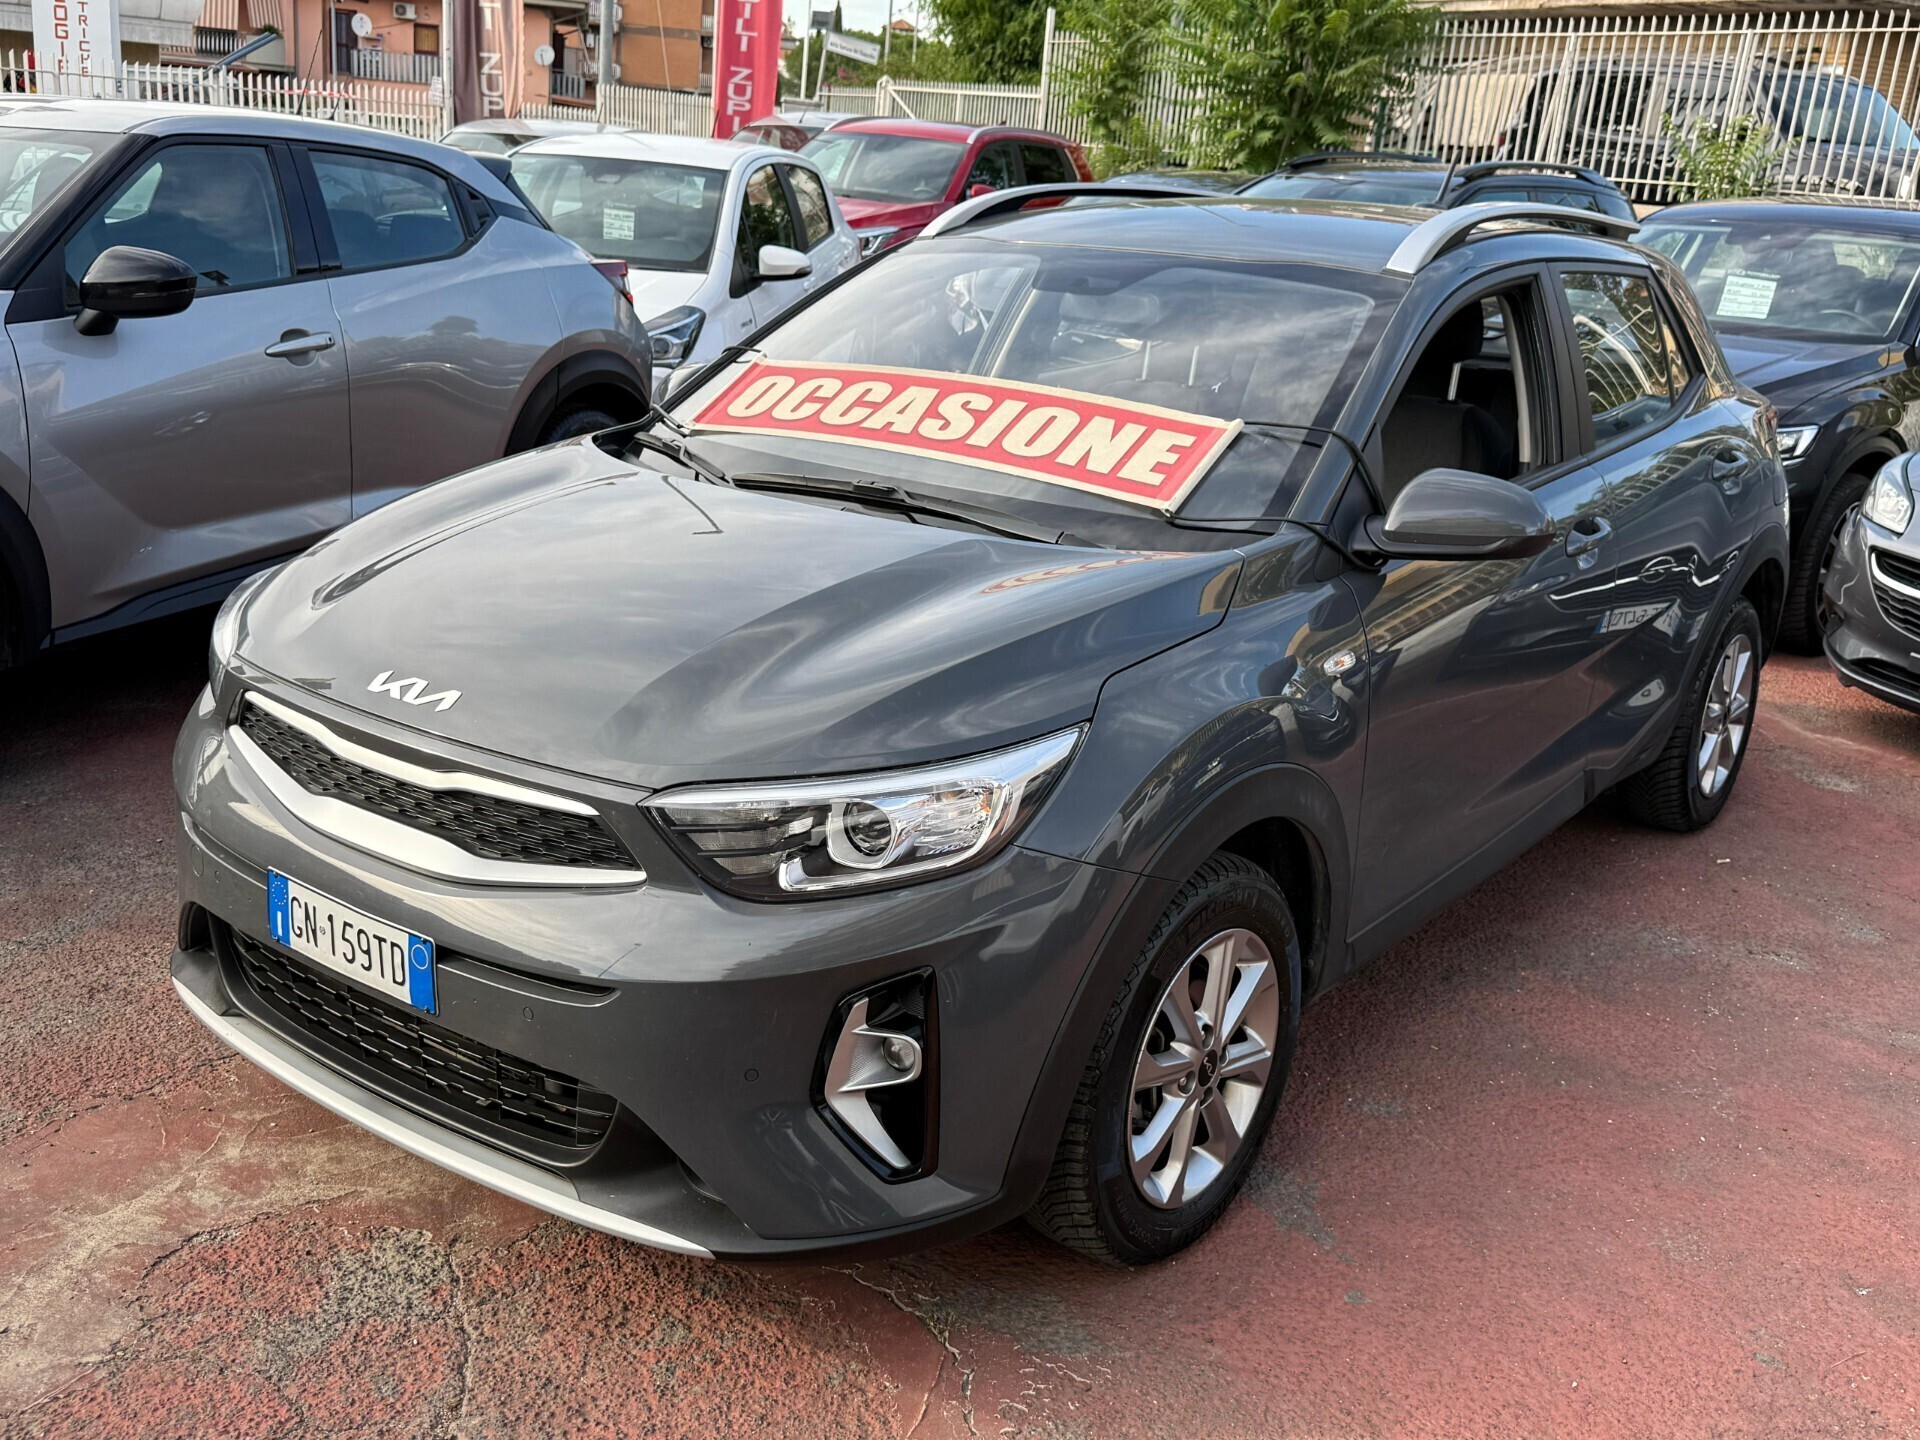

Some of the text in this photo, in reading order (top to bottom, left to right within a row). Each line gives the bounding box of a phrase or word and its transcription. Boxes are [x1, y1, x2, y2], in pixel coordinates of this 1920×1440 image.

[726, 66, 753, 133] ZUPI
[726, 375, 1197, 486] OCCASIONE
[366, 670, 462, 712] KIA
